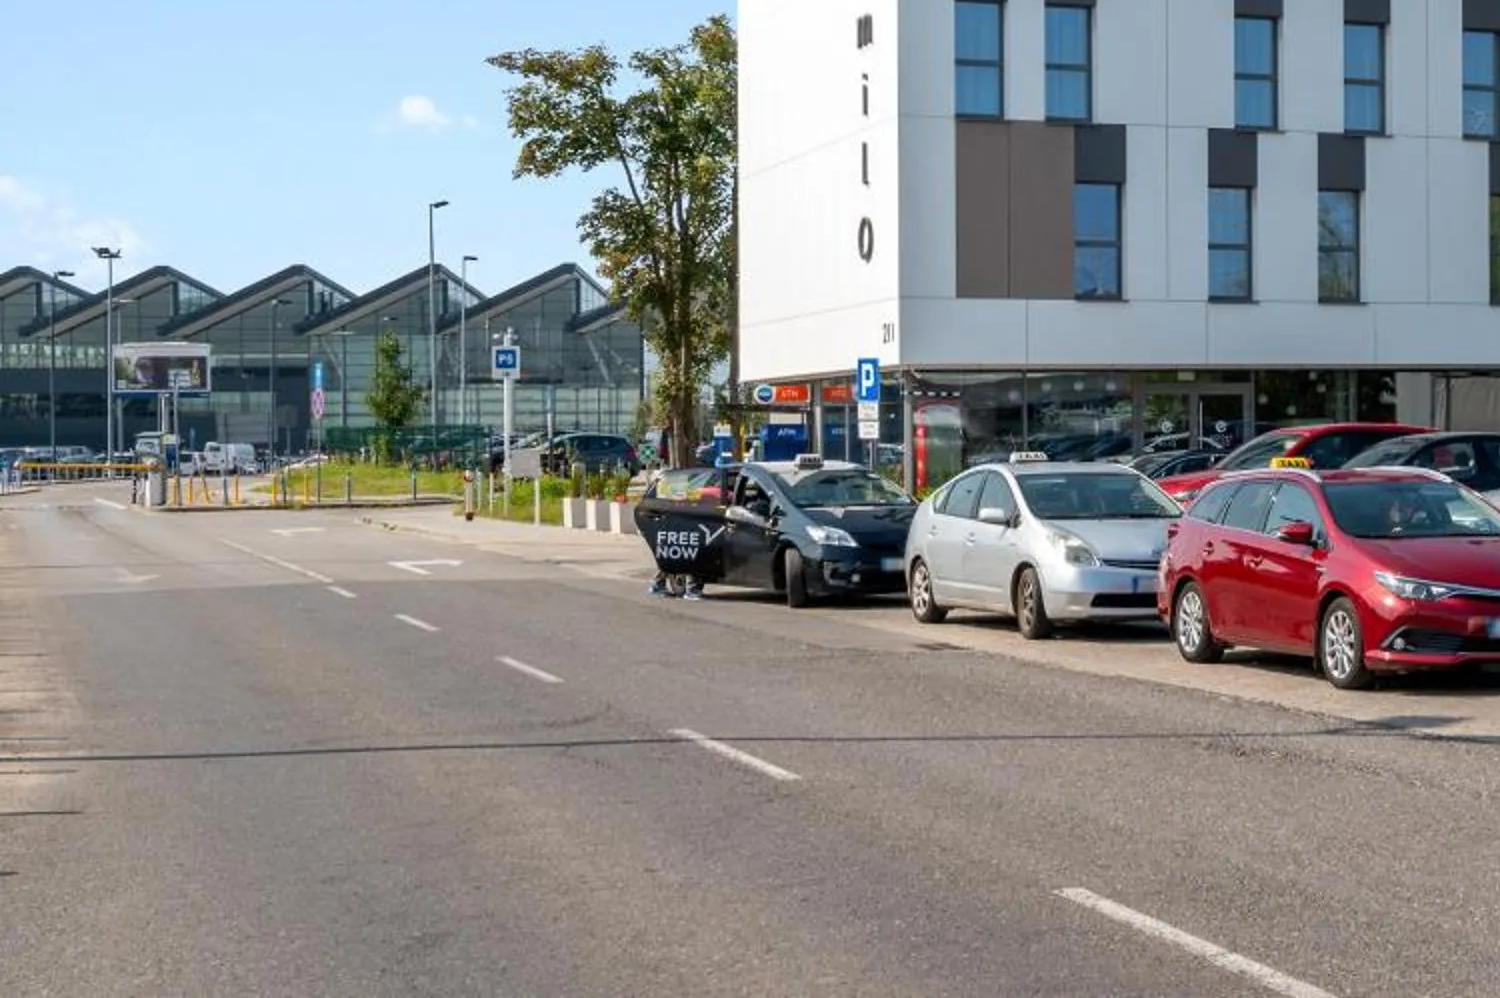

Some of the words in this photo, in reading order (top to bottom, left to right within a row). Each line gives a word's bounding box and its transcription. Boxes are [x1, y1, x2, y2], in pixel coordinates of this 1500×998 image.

[861, 363, 874, 397] P
[657, 531, 699, 545] FREE
[656, 546, 699, 560] NOW
